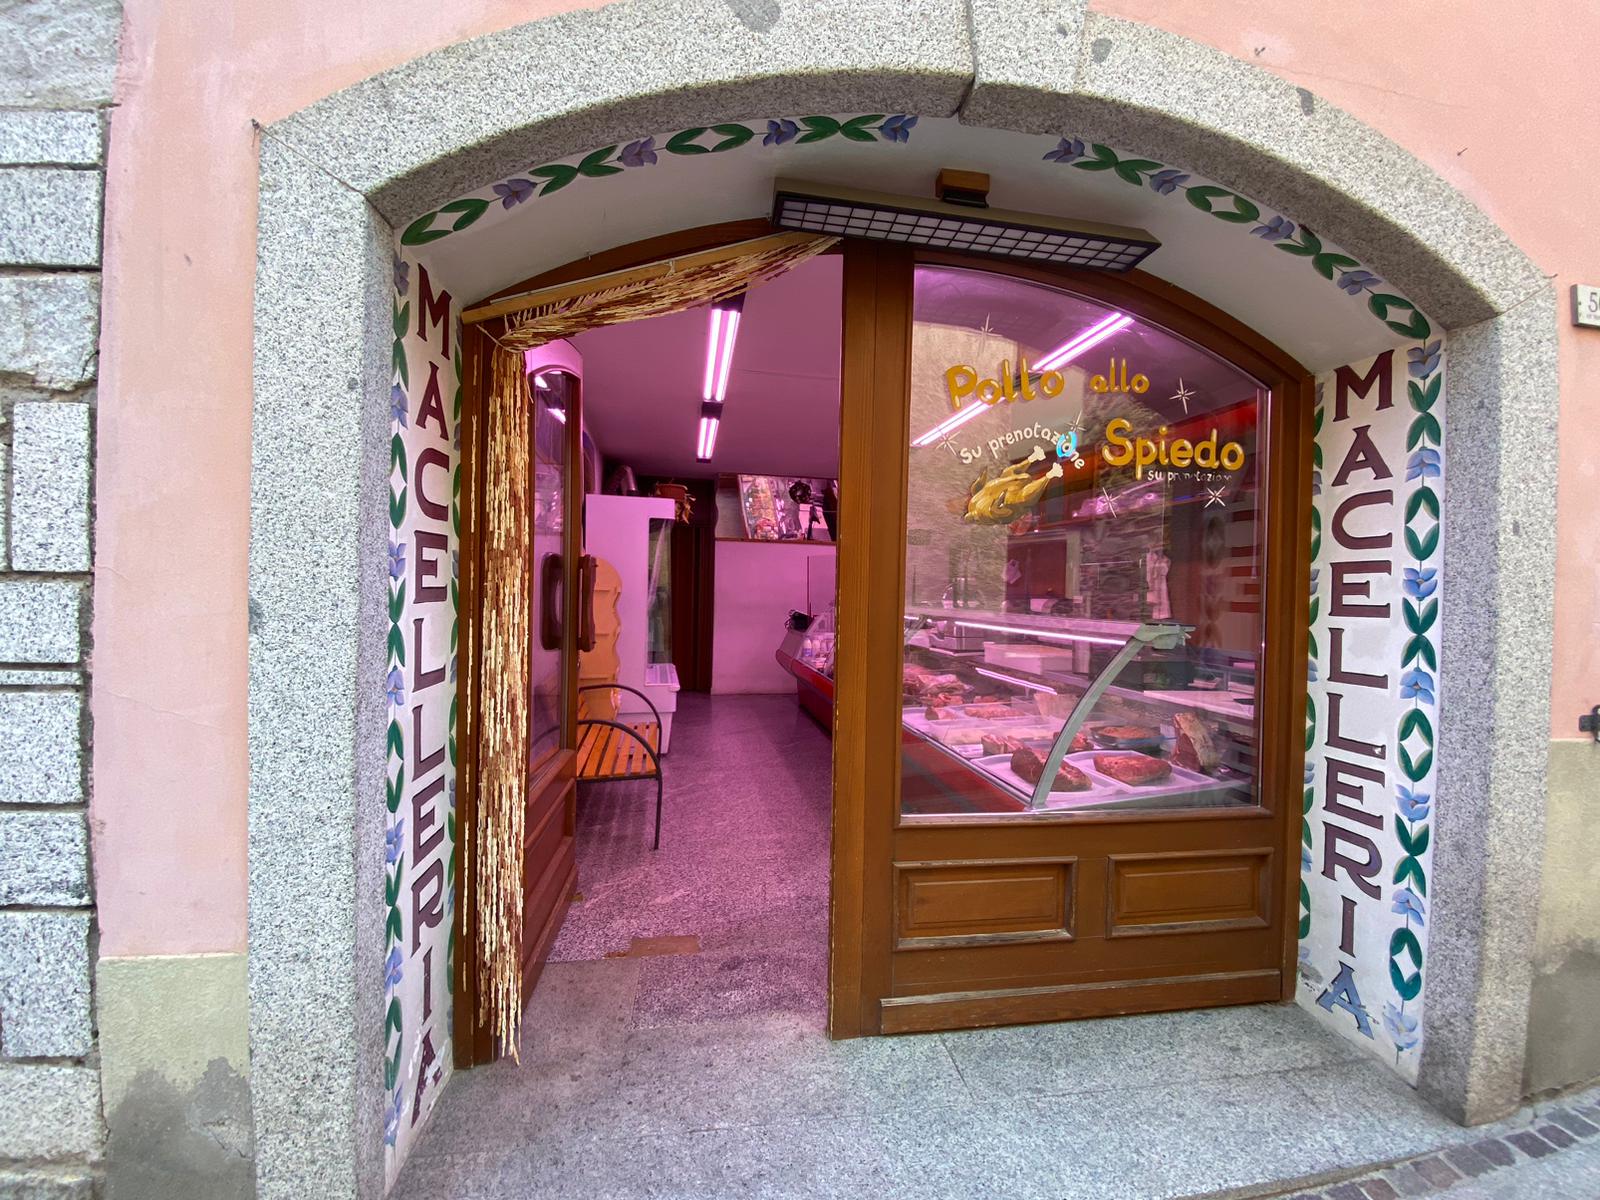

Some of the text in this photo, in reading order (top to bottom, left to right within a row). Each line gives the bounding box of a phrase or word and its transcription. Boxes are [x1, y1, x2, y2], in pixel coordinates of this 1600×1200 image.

[1588, 291, 1600, 312] 5
[944, 357, 1150, 409] Pollo allo
[988, 422, 1085, 470] prenotazione
[1102, 418, 1245, 481] Spiedo
[410, 262, 452, 1128] MACELLERIA
[1315, 349, 1395, 1040] MACELLERIA
